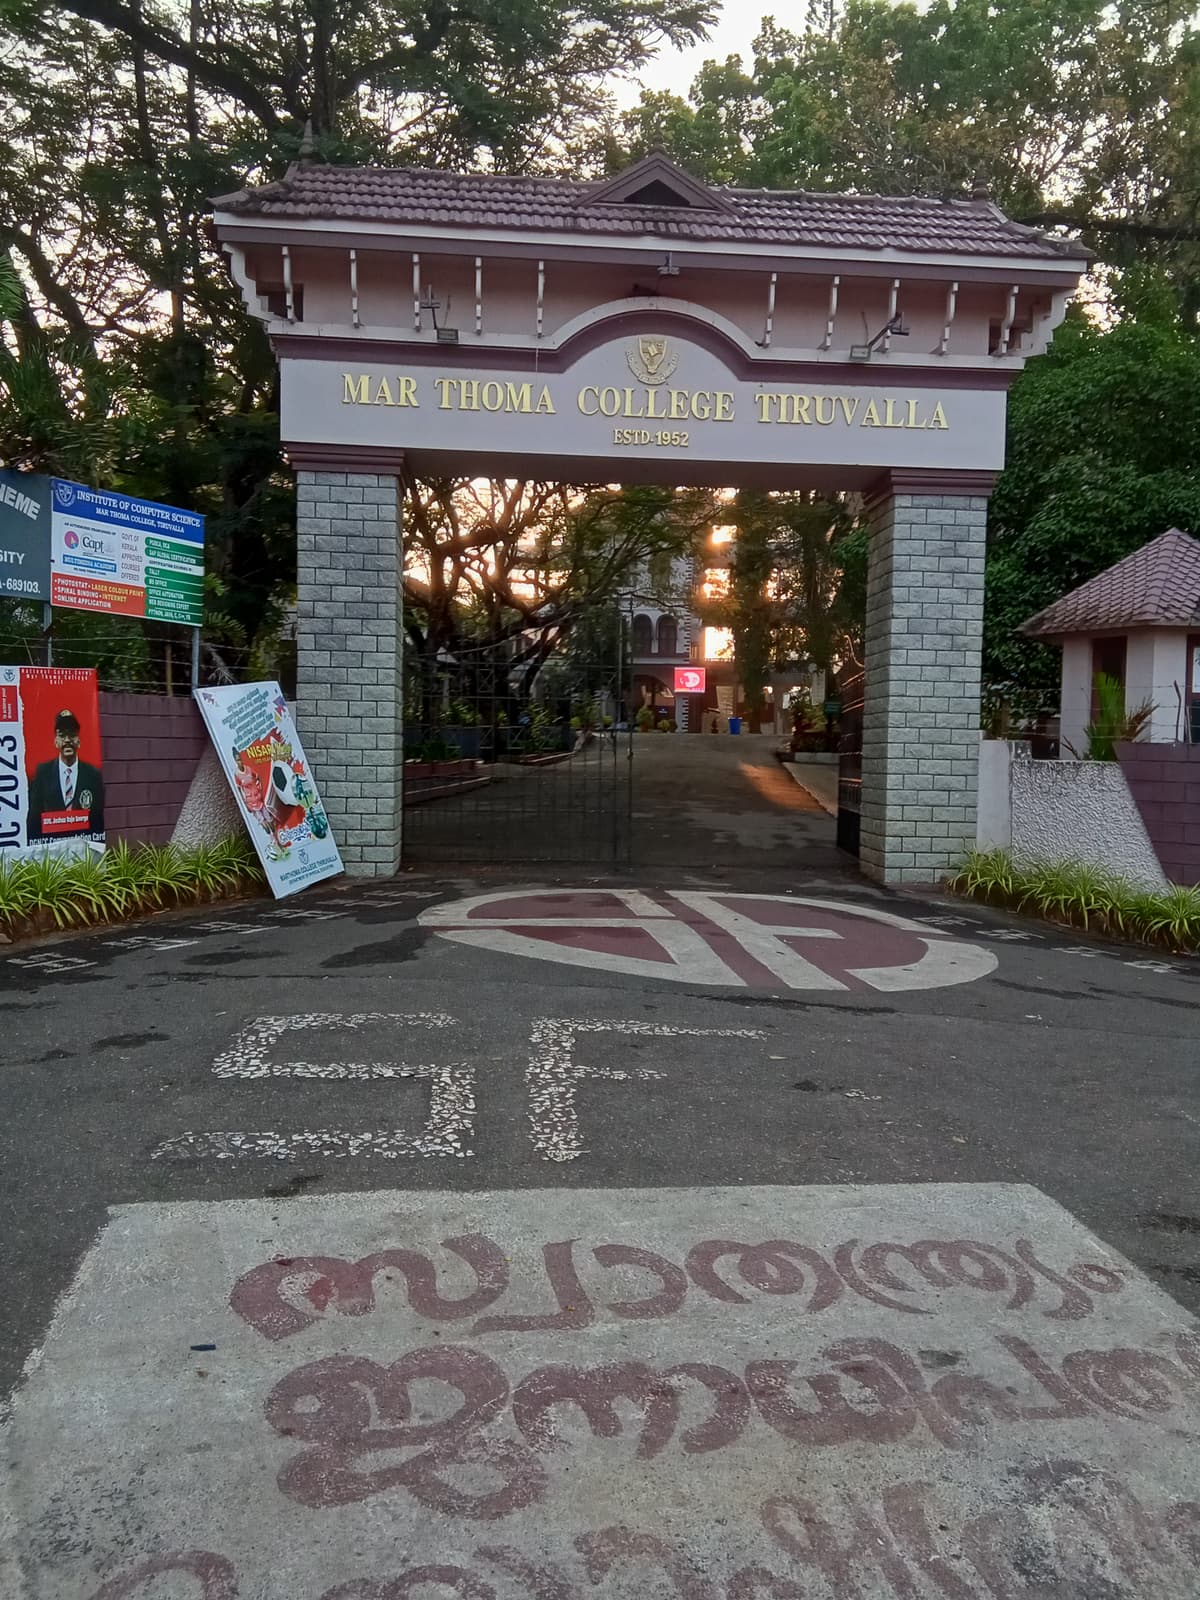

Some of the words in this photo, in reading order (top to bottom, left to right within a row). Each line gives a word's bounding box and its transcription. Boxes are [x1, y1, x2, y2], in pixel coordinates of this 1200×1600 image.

[342, 373, 420, 408] MAR
[434, 377, 557, 414] THOMA
[577, 385, 735, 422] COLLEGE
[754, 392, 950, 430] TIRUVALLA
[77, 490, 118, 508] INSTITUTE
[119, 501, 130, 511] OF
[131, 503, 171, 520] COMPUTER
[172, 512, 200, 528] SCIENCE
[96, 507, 109, 517] MAR
[110, 509, 130, 521] THOMA
[57, 578, 88, 588] PHOTOSTAT
[129, 588, 144, 597] PRINT
[57, 586, 76, 595] SPIRAL
[102, 593, 127, 602] INTERNET
[57, 595, 76, 603] ONLINE
[78, 598, 111, 608] APPLICATION
